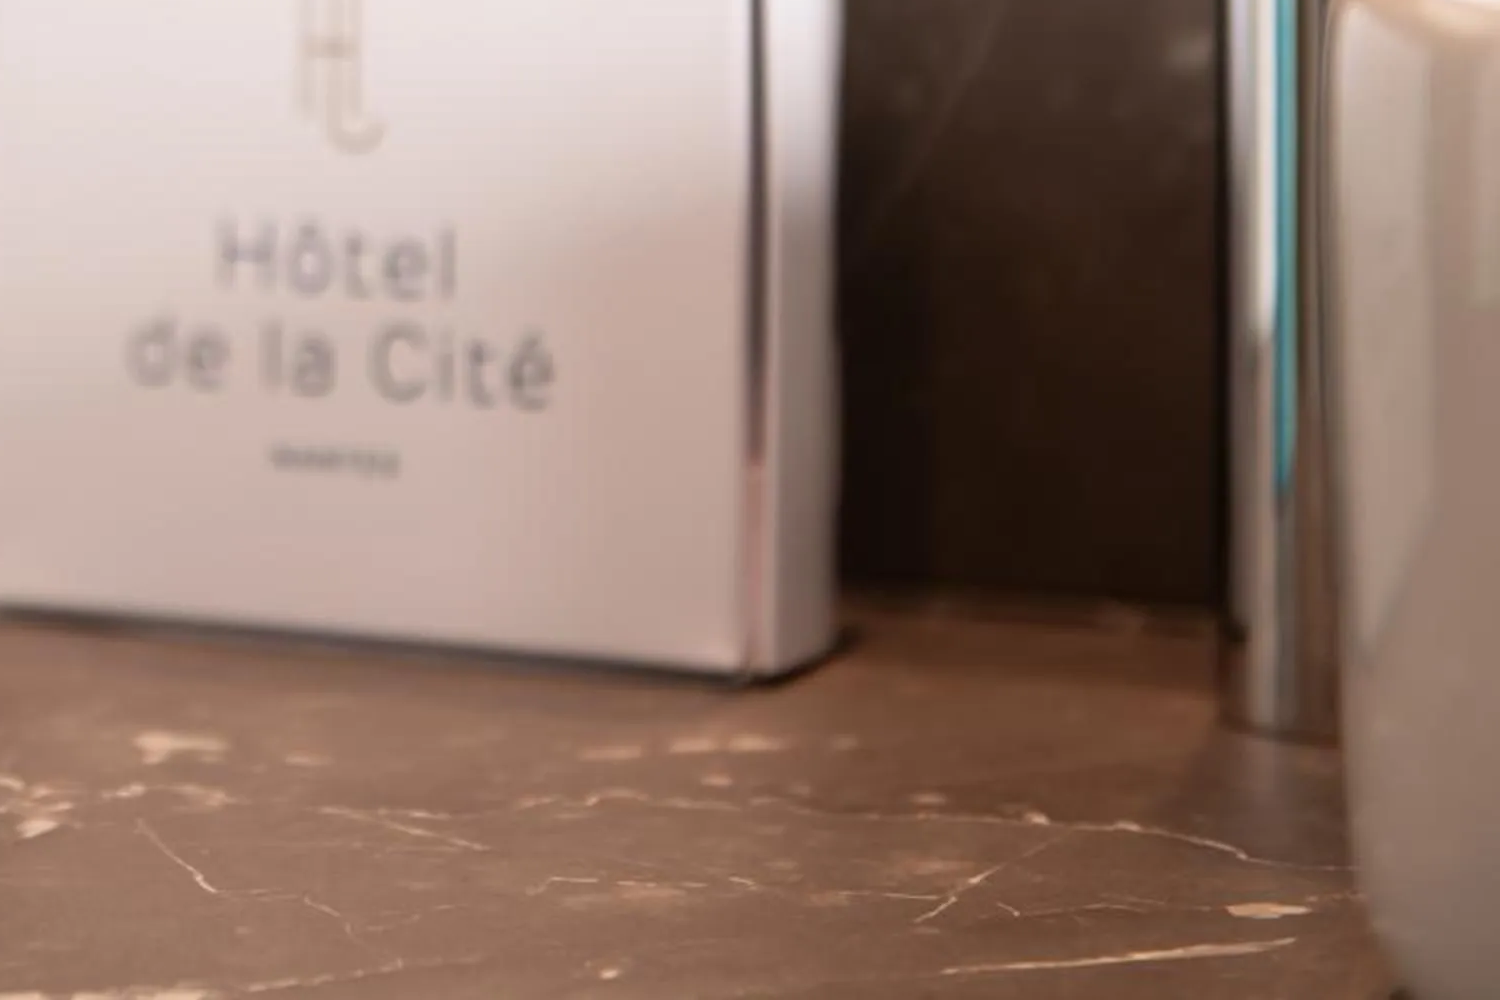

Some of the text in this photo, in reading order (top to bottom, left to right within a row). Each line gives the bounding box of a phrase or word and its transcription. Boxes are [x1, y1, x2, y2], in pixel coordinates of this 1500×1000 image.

[213, 212, 458, 301] Hôtel
[123, 308, 556, 414] de la Cité
